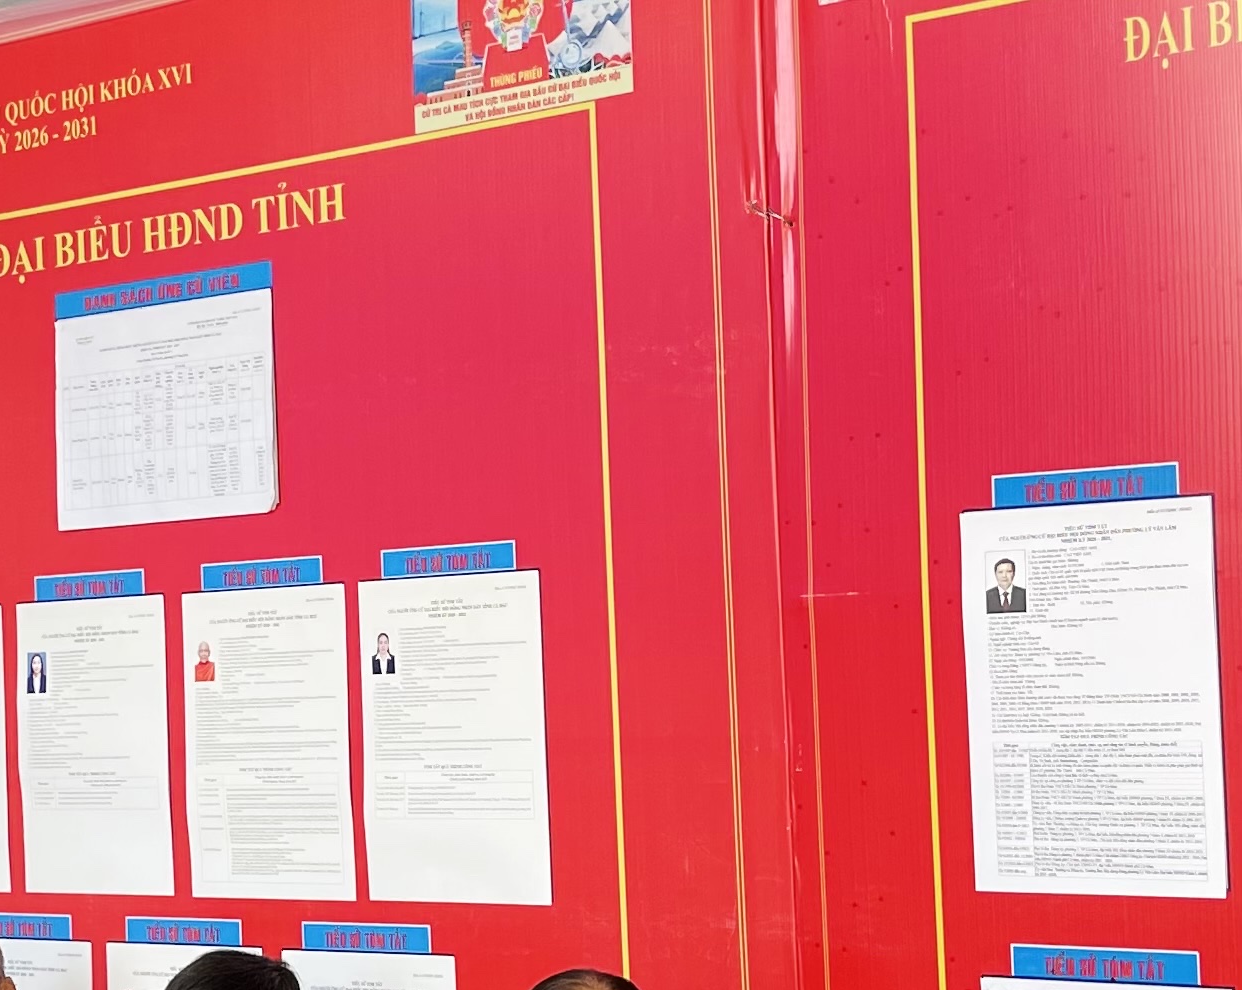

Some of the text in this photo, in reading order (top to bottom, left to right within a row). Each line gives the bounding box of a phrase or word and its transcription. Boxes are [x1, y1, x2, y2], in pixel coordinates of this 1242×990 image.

[1123, 6, 1195, 70] ĐẠI
[4, 90, 57, 127] QUỐC
[61, 83, 95, 112] HỘI
[99, 68, 155, 103] KHÓA
[158, 63, 192, 91] XVI
[14, 125, 49, 152] 2026
[63, 116, 97, 142] 2031
[54, 215, 133, 268] BIỂU
[141, 203, 244, 253] HĐND
[251, 181, 347, 235] TỈNH
